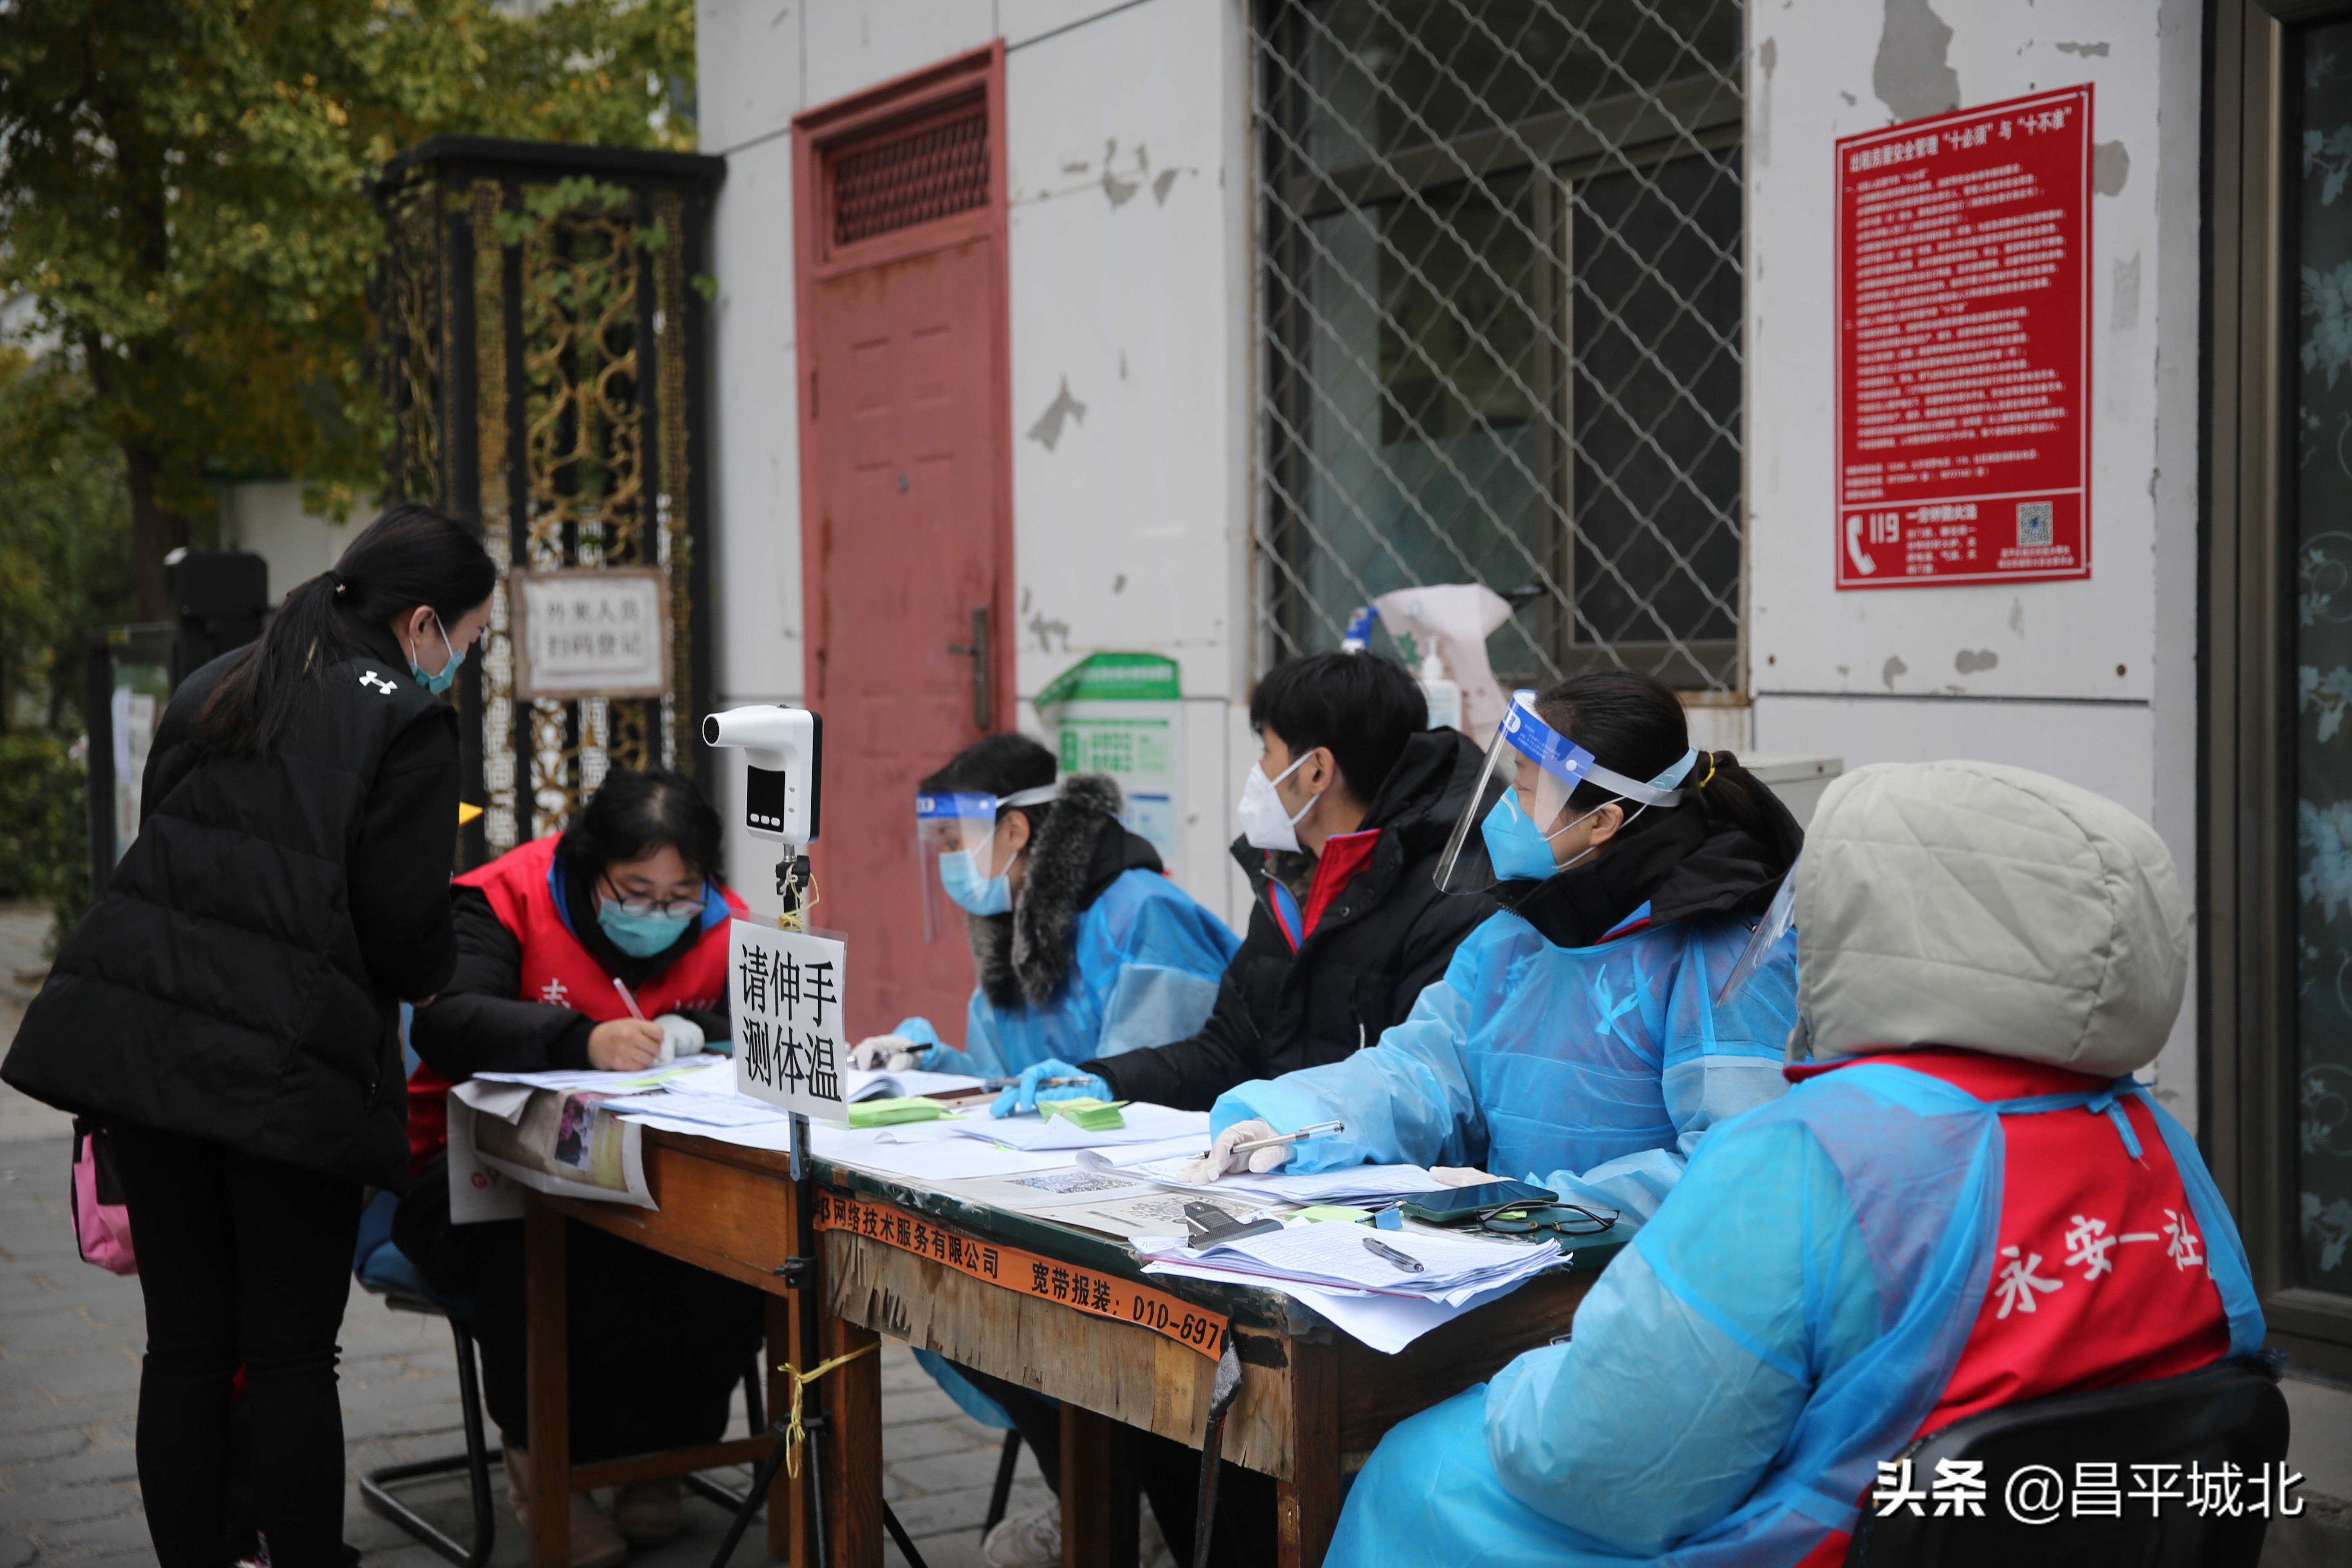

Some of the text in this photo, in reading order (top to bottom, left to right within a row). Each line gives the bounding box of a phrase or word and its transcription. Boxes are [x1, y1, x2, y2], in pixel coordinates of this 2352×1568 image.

[1869, 512, 1900, 544] 119
[546, 597, 640, 624] 外来人员
[547, 630, 643, 657] 扫码登记
[738, 944, 837, 1027] 请伸手
[742, 1016, 842, 1102] 测体温
[1994, 1207, 2214, 1320] 永安一社
